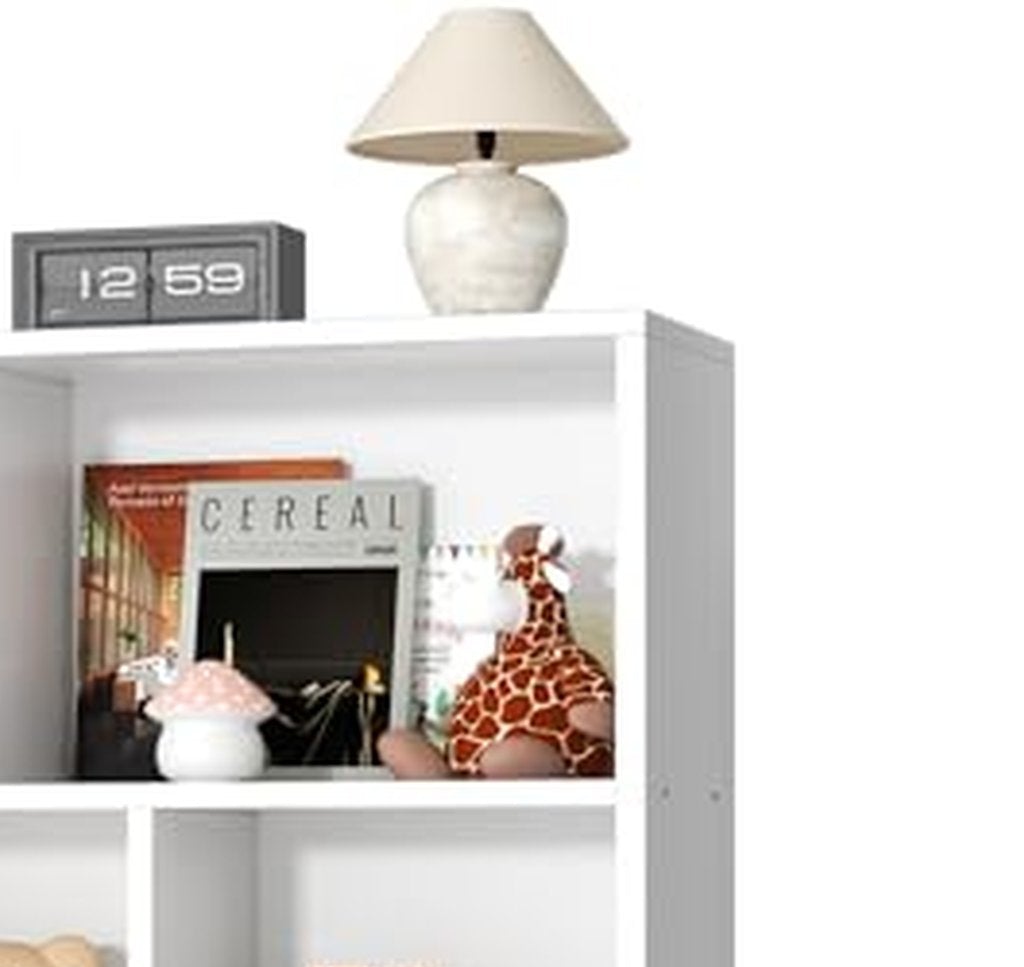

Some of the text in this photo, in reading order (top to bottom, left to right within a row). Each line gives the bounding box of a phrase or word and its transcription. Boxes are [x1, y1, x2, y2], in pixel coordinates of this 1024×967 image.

[80, 262, 245, 300] 12 59
[199, 494, 404, 533] CEREAL
